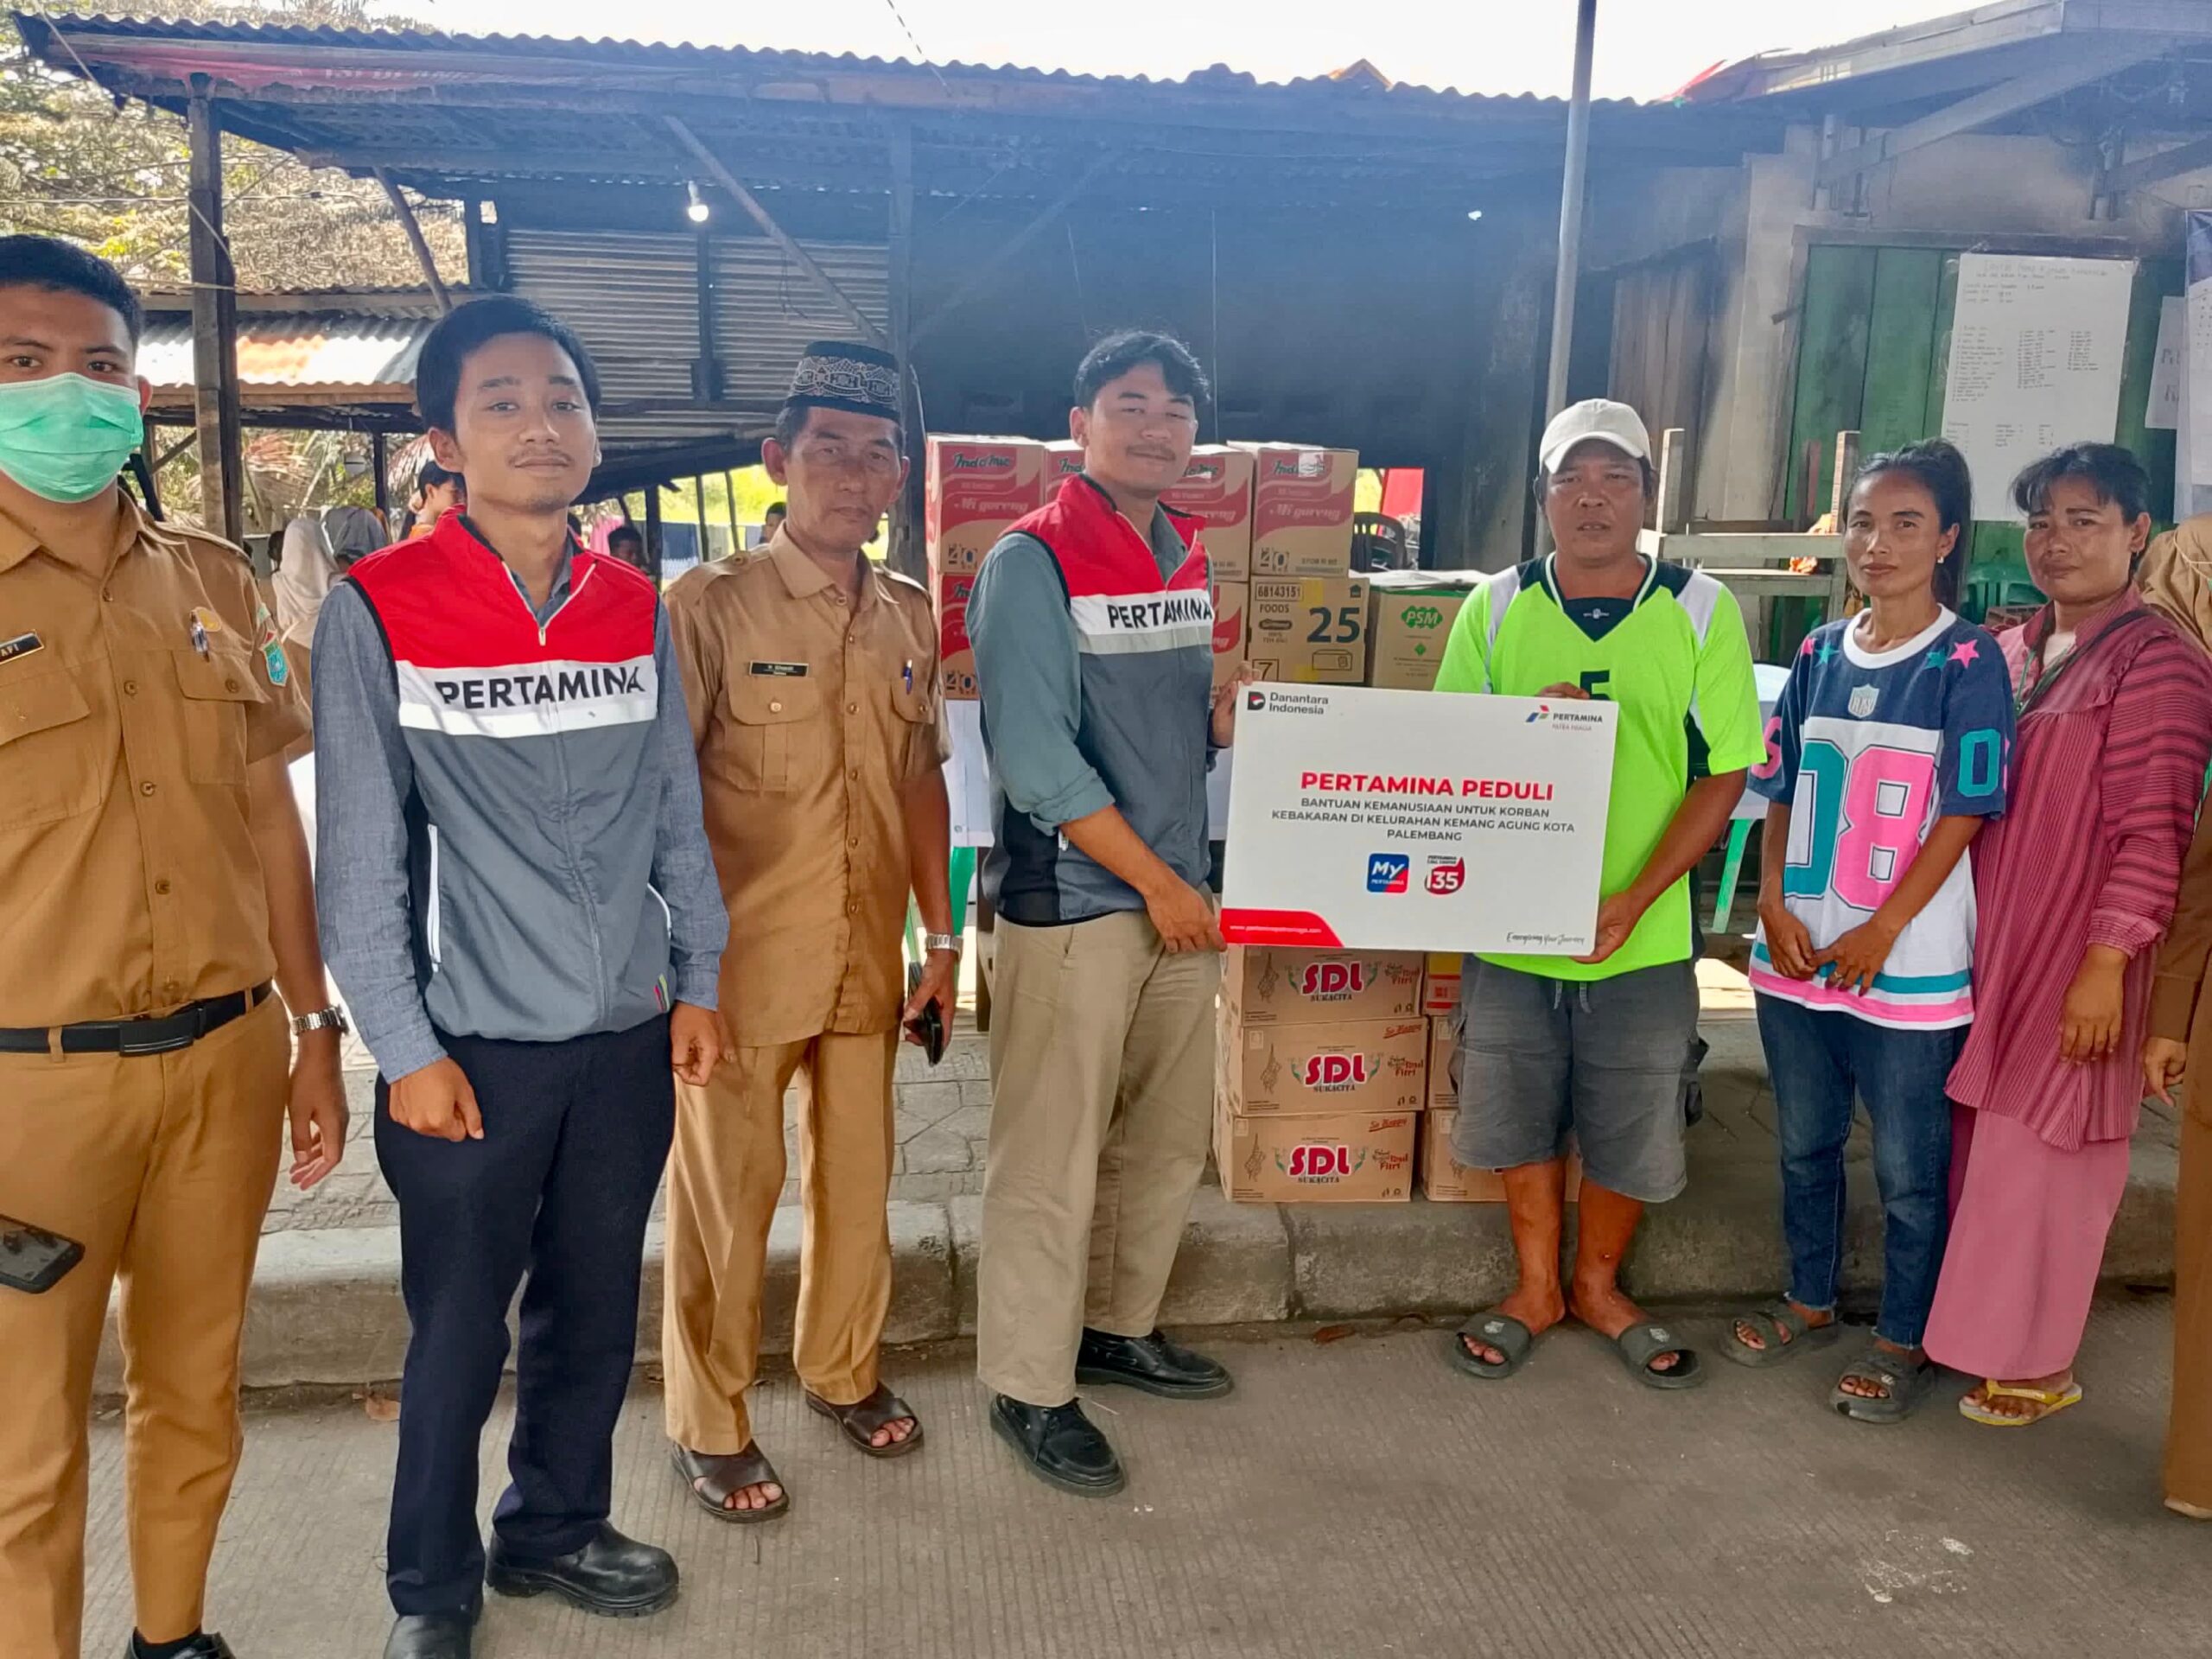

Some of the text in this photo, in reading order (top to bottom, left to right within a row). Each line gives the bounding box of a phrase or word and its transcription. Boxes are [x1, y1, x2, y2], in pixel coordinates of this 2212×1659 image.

[1107, 598, 1213, 629] PERTAMINA
[1259, 603, 1290, 613] FOODS
[1306, 607, 1361, 644] 25
[435, 666, 646, 709] PERTAMINA
[1268, 702, 1325, 715] Indonesia
[1269, 692, 1329, 705] Danantara
[1553, 713, 1604, 723] PERTAMINA
[1300, 772, 1554, 801] PERTAMINA PEDULI
[1300, 798, 1549, 818] BANTUAN KEMANUSIAAN UNTUK KORBAN
[1272, 810, 1575, 833] KEBAKARAN DI KELURAHAN KEMANG AGUNG KOTA
[1387, 829, 1463, 842] PALEMBANG
